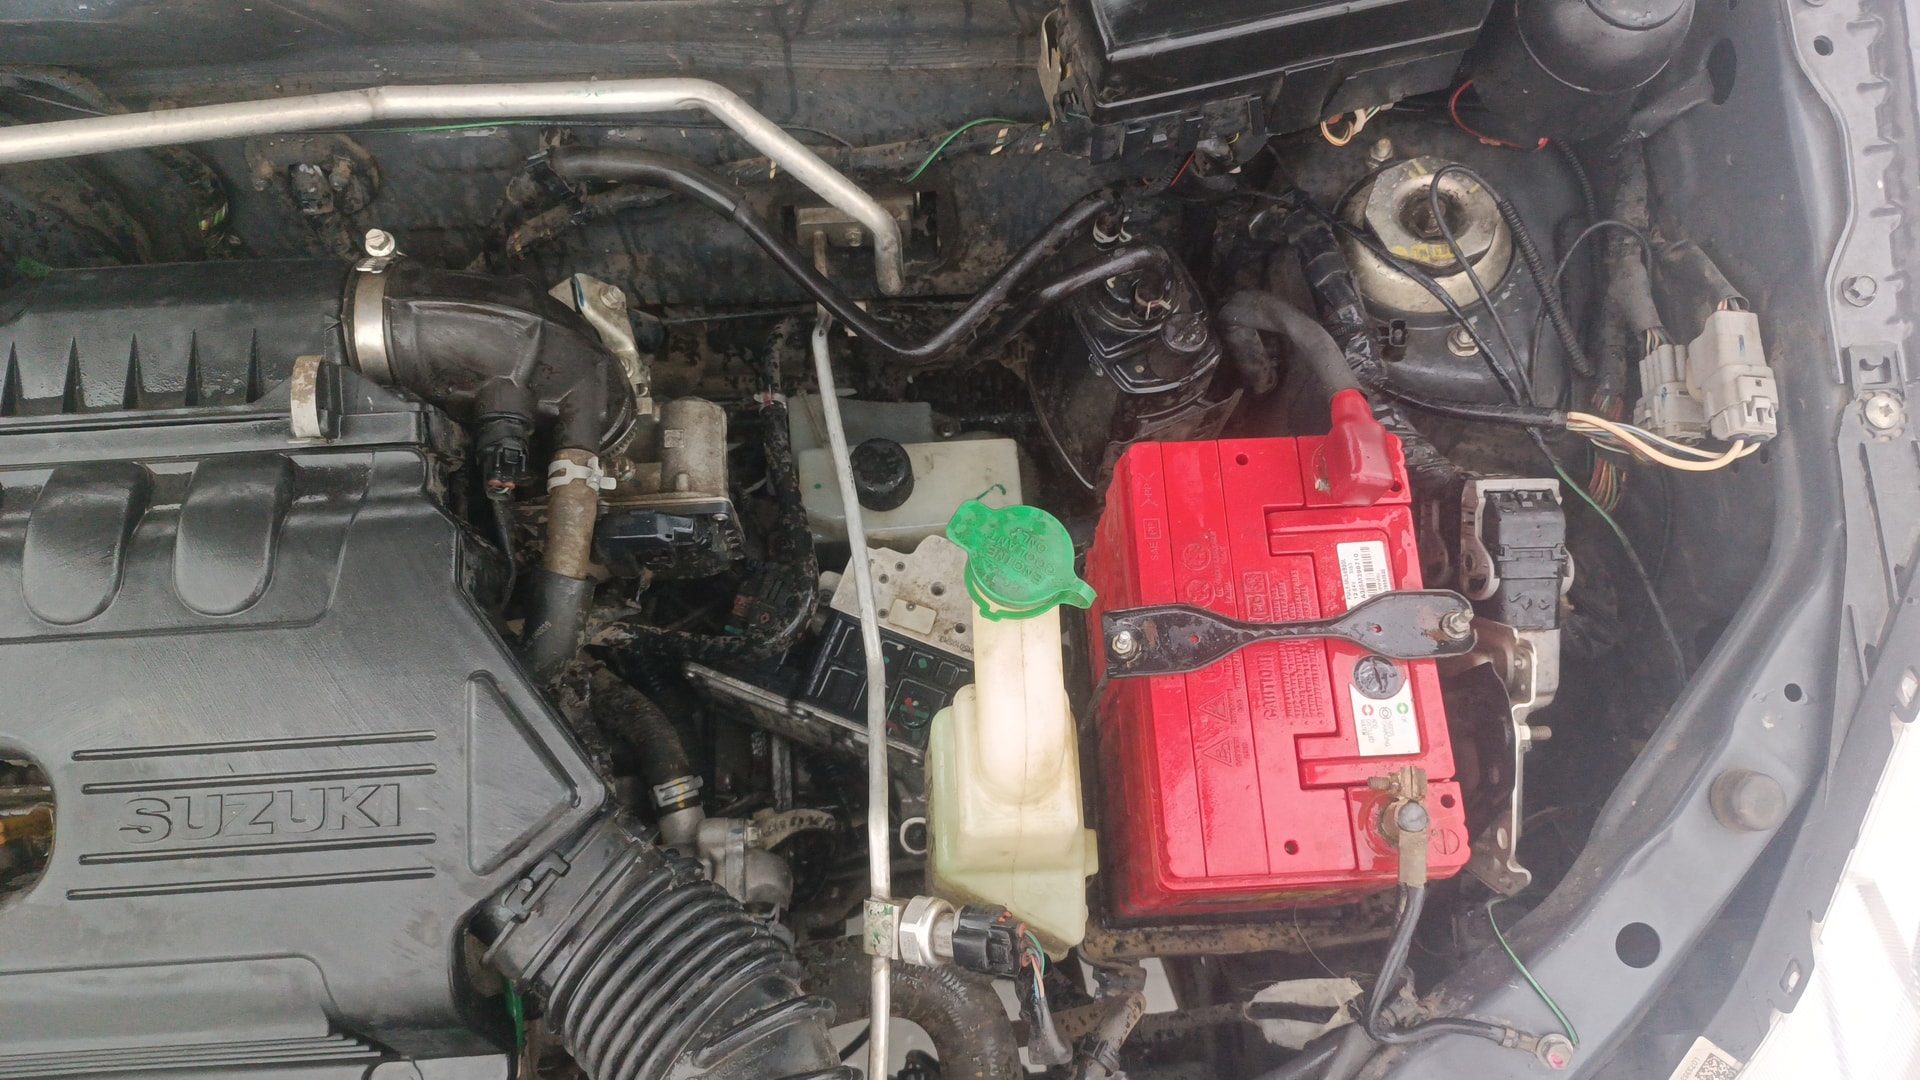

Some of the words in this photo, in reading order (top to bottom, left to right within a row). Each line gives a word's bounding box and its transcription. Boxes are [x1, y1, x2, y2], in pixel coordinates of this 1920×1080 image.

[988, 534, 1056, 576] COOLANT
[1010, 527, 1048, 554] ONLY
[986, 543, 1045, 585] ENGINE
[118, 783, 403, 844] SUZUKI
